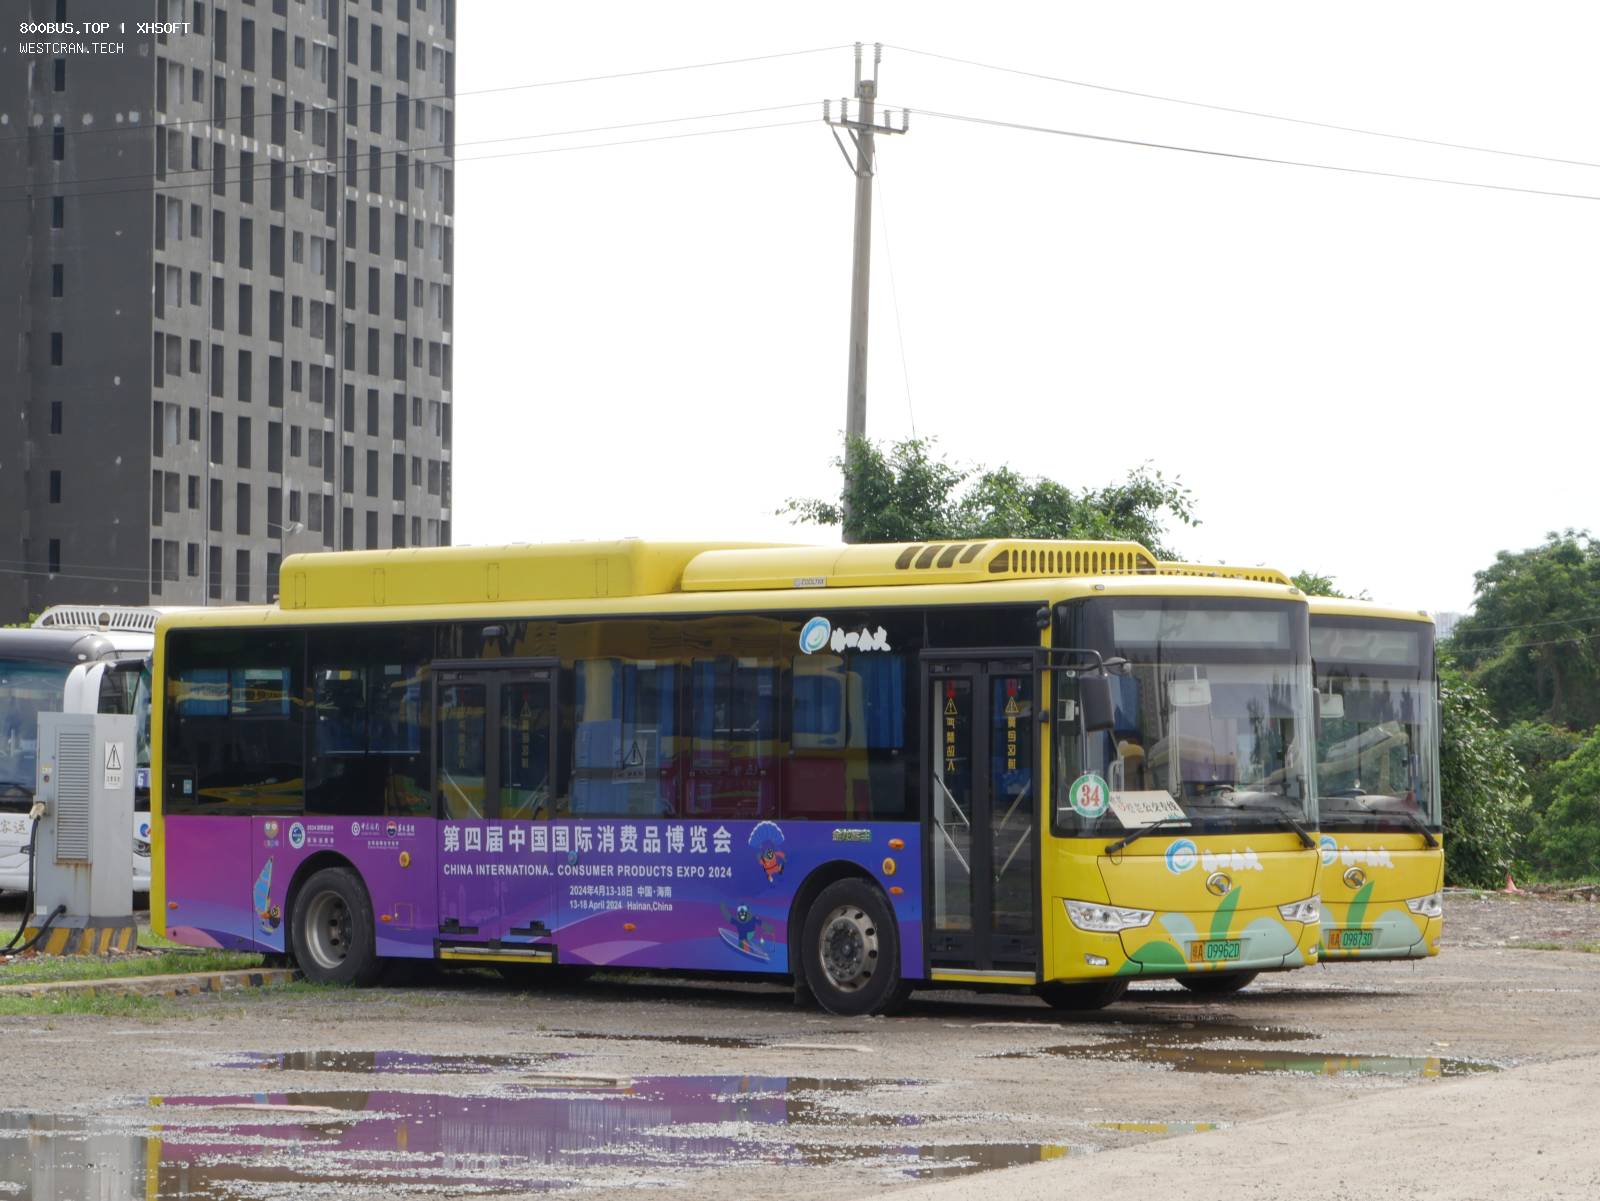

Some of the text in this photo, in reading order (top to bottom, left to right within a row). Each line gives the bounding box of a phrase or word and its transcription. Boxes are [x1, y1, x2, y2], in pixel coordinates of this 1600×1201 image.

[1081, 784, 1101, 807] 34
[443, 825, 732, 853] 第四届中国国际消费品博览会
[443, 864, 732, 878] CHINA INTERNATIONA CONSUMER PRODUCTS EXPO 2024
[569, 885, 633, 897] 2024年4月13-18日
[569, 900, 588, 909] 13-18
[588, 900, 605, 911] April
[606, 900, 622, 910] 2024
